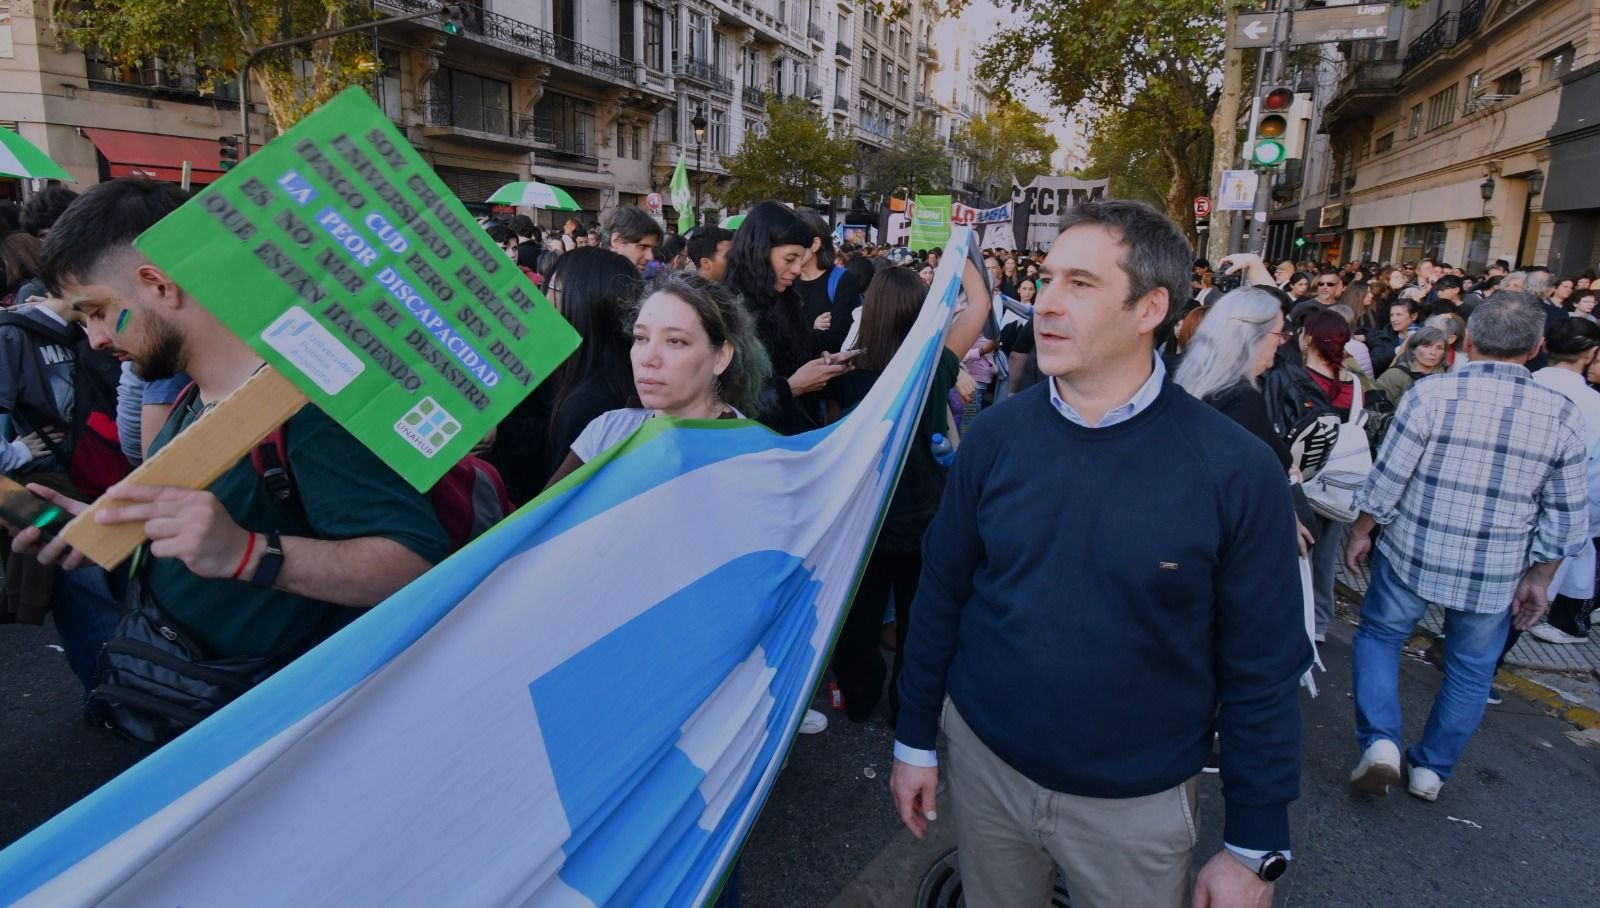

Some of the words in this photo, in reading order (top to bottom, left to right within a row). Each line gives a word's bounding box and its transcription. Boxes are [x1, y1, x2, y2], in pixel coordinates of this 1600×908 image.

[201, 192, 257, 241] QUE
[278, 169, 315, 204] LA
[319, 210, 378, 266] PEOR
[376, 265, 500, 389] DISCAPACIDAD
[294, 139, 368, 212] TENGO
[363, 210, 410, 256] CUD
[404, 252, 455, 303] PERO
[456, 306, 490, 340] SIN
[488, 340, 534, 386] DUDA
[329, 132, 454, 261] UNIVERSIDAD
[364, 128, 407, 171] SOY
[404, 173, 501, 276] GRADUADO
[508, 286, 535, 314] DE
[239, 176, 274, 207] ES
[276, 211, 316, 247] NO
[316, 249, 364, 293] VER
[372, 301, 403, 329] EL
[404, 328, 490, 411] DESASTRE
[396, 421, 433, 456] UNAHUR
